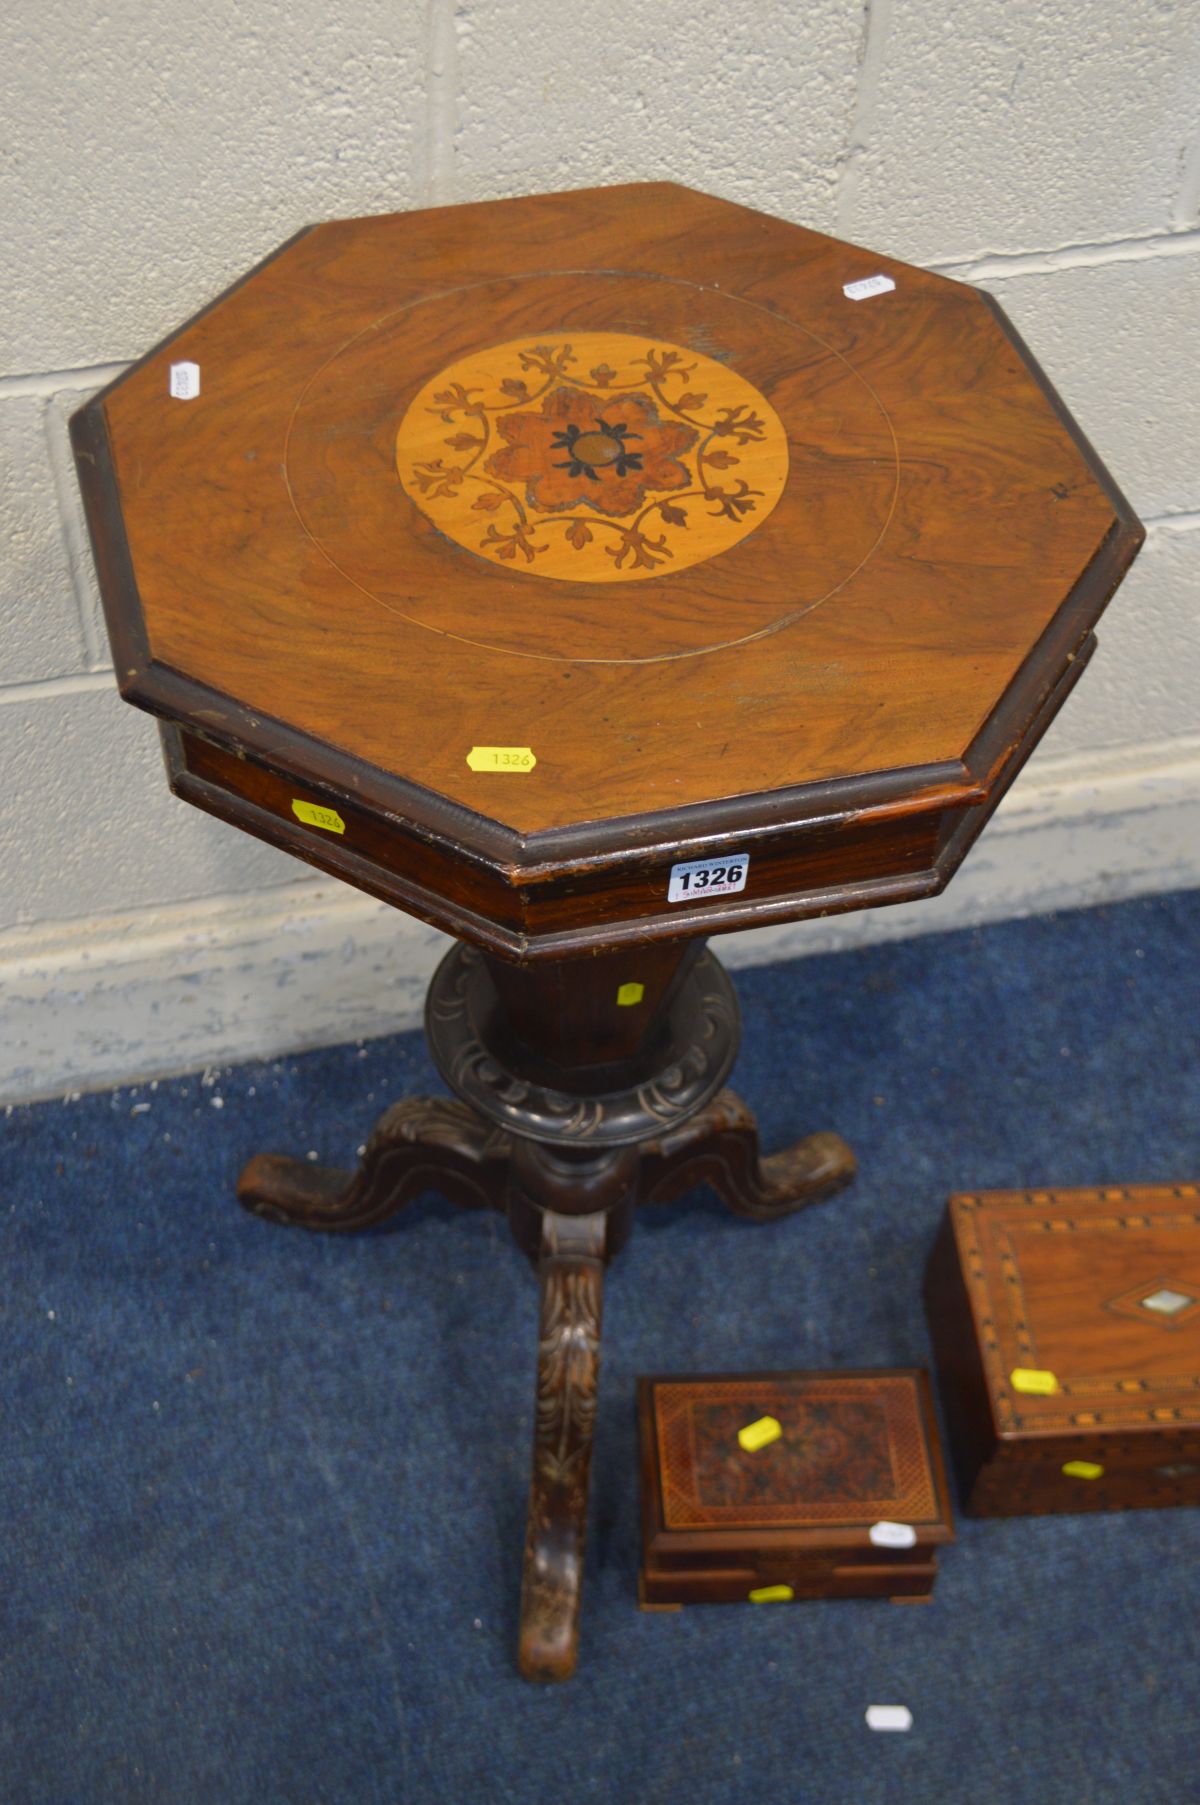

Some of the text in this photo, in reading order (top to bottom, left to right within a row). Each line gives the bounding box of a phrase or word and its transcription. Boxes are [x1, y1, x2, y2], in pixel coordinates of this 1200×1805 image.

[493, 753, 530, 766] 1326
[311, 810, 341, 828] 1326
[677, 857, 748, 872] RICHARD WINTERTON
[679, 865, 743, 890] 1326
